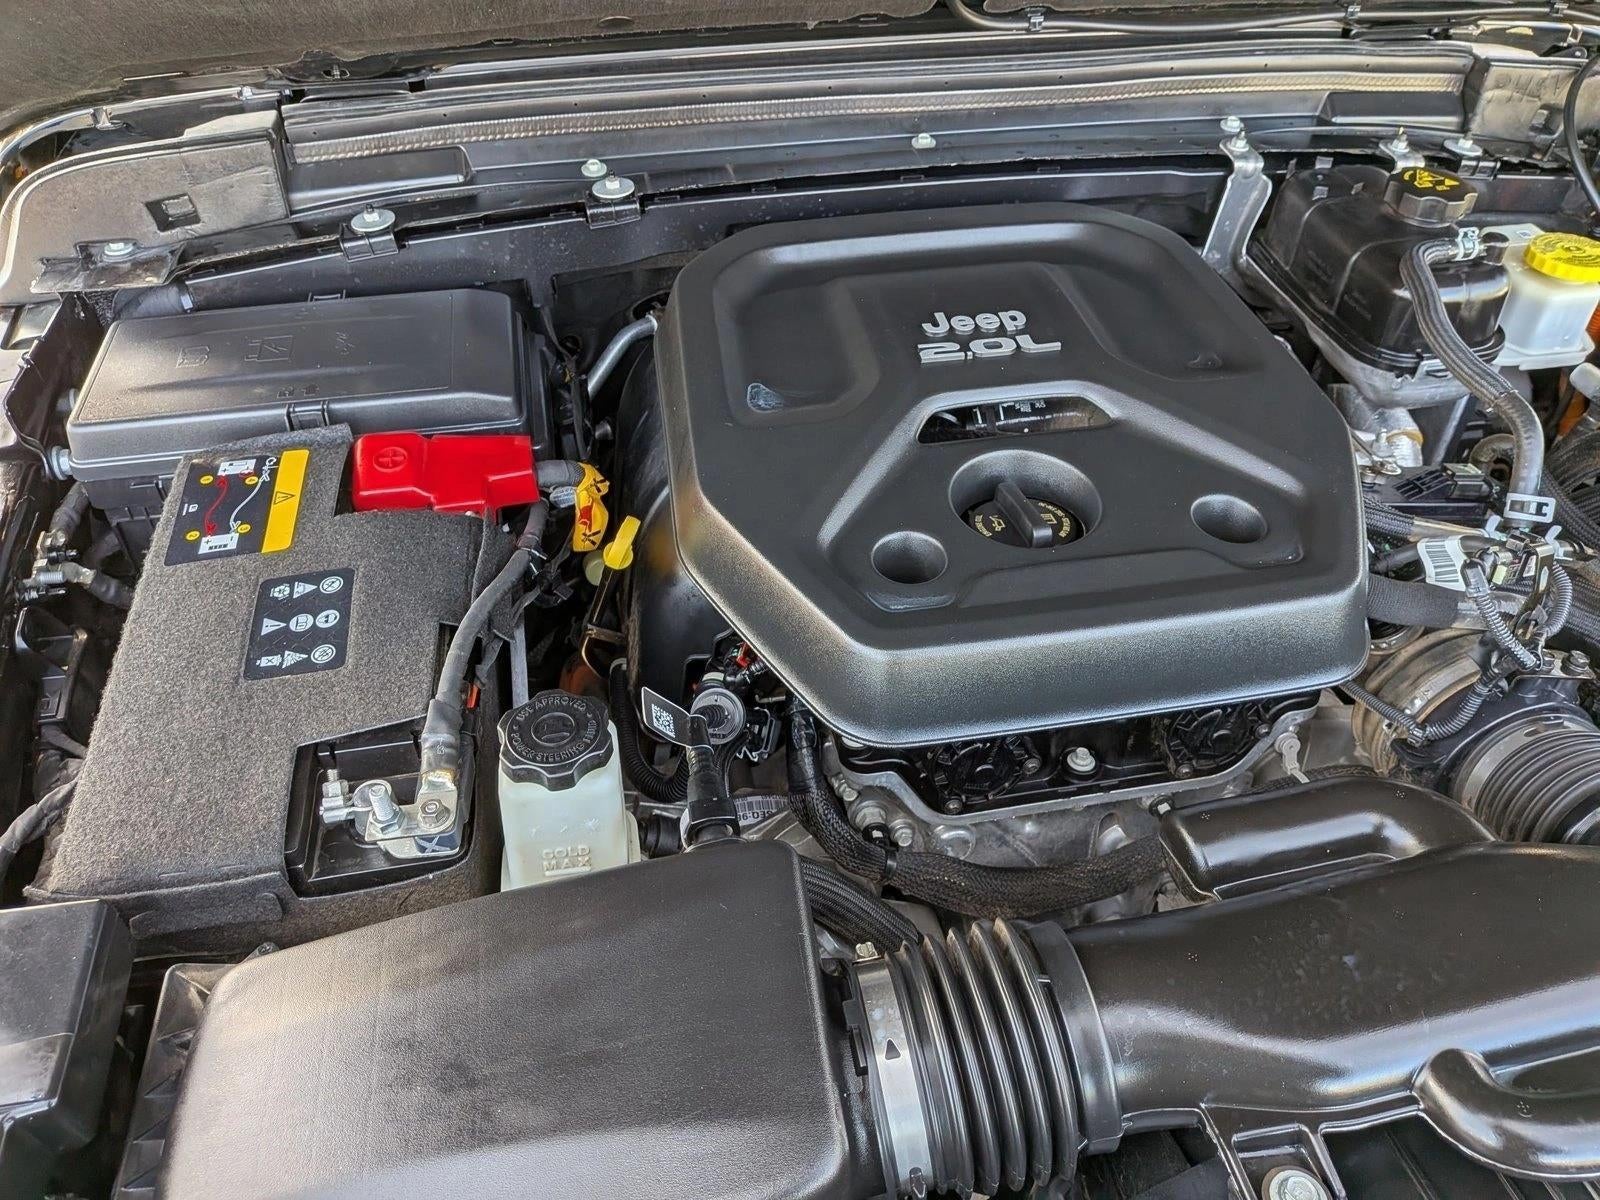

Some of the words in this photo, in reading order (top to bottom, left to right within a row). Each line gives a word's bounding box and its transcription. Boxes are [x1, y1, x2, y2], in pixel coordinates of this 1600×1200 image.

[921, 310, 1027, 336] Jeep
[917, 334, 1062, 363] 2.0L
[516, 705, 534, 721] USE
[535, 696, 587, 712] APPROVED
[511, 733, 536, 759] POWER
[536, 742, 585, 761] STEERING
[542, 844, 590, 859] COLD
[542, 856, 591, 872] MAX
